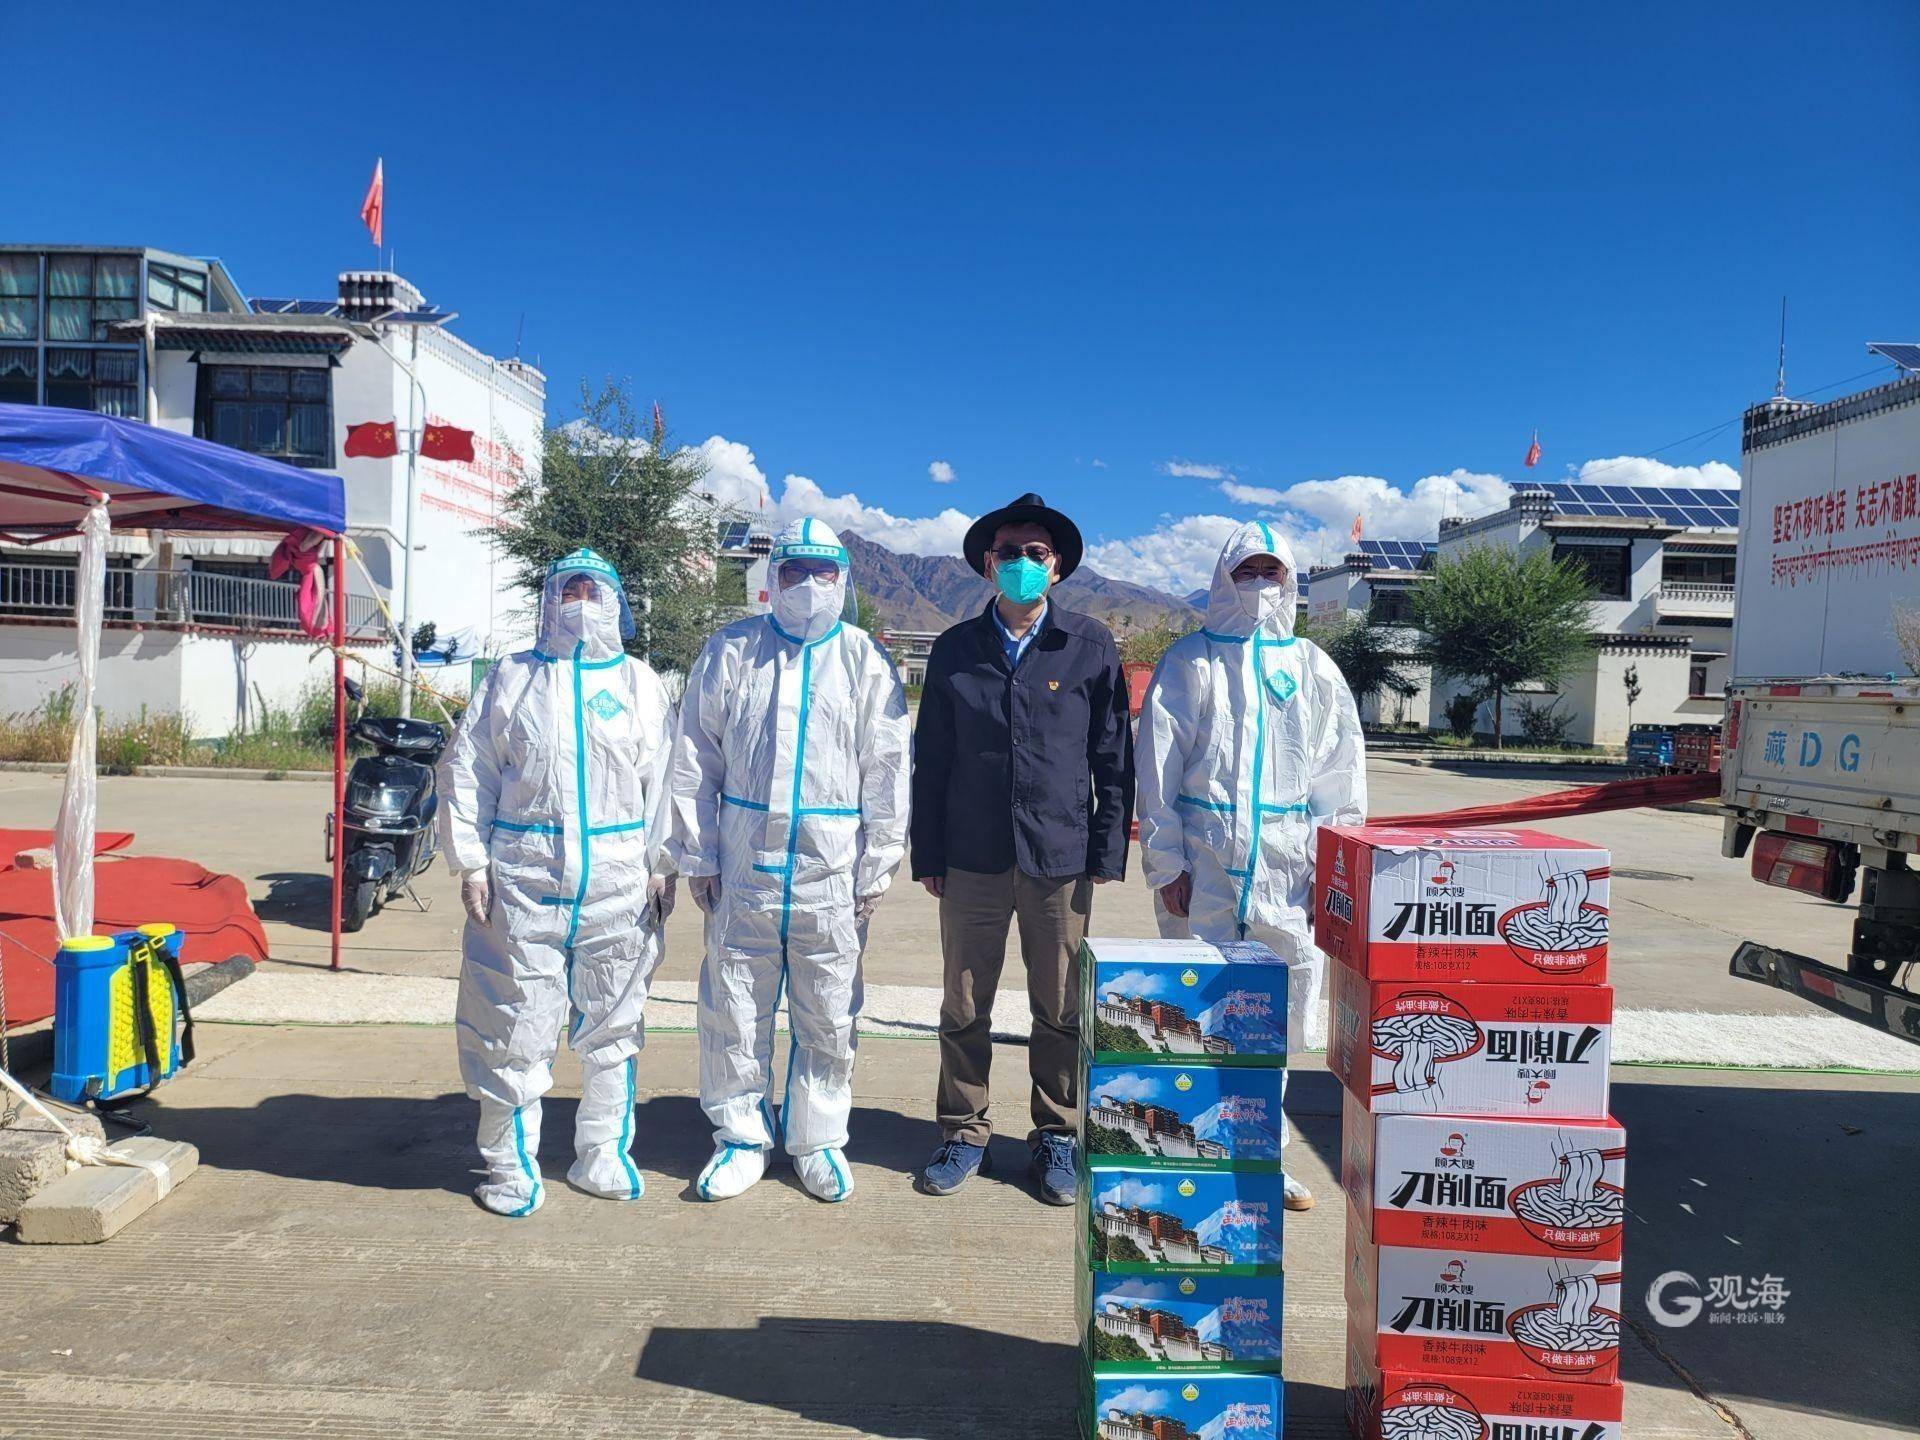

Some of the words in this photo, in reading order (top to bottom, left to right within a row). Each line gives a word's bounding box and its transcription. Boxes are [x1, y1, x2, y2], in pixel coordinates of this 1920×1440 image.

[1773, 489, 1846, 544] 坚定不移听党话
[1855, 473, 1920, 529] 矢志不渝跟
[1426, 886, 1465, 897] 顾大嫂
[1382, 902, 1496, 941] 刀削面
[1415, 946, 1479, 959] 香辣牛肉味
[1532, 953, 1587, 965] 只做非油炸
[1394, 1001, 1451, 1012] 只做非油炸
[1504, 1007, 1568, 1019] 香辣牛肉味
[1486, 1025, 1602, 1064] 刀削面
[1517, 1069, 1557, 1079] 顾大嫂
[1434, 1157, 1475, 1170] 顾大嫂
[1388, 1170, 1507, 1210] 刀削面
[1422, 1215, 1488, 1231] 香辣牛肉味
[1543, 1229, 1600, 1242] 只做非油炸
[1434, 1282, 1474, 1295] 顾大嫂
[1389, 1296, 1505, 1334] 刀削面
[1423, 1340, 1487, 1355] 香辣牛肉味
[1540, 1353, 1597, 1365] 只做非油炸
[1401, 1392, 1456, 1404] 只做非油炸
[1509, 1401, 1573, 1416] 香辣牛肉味
